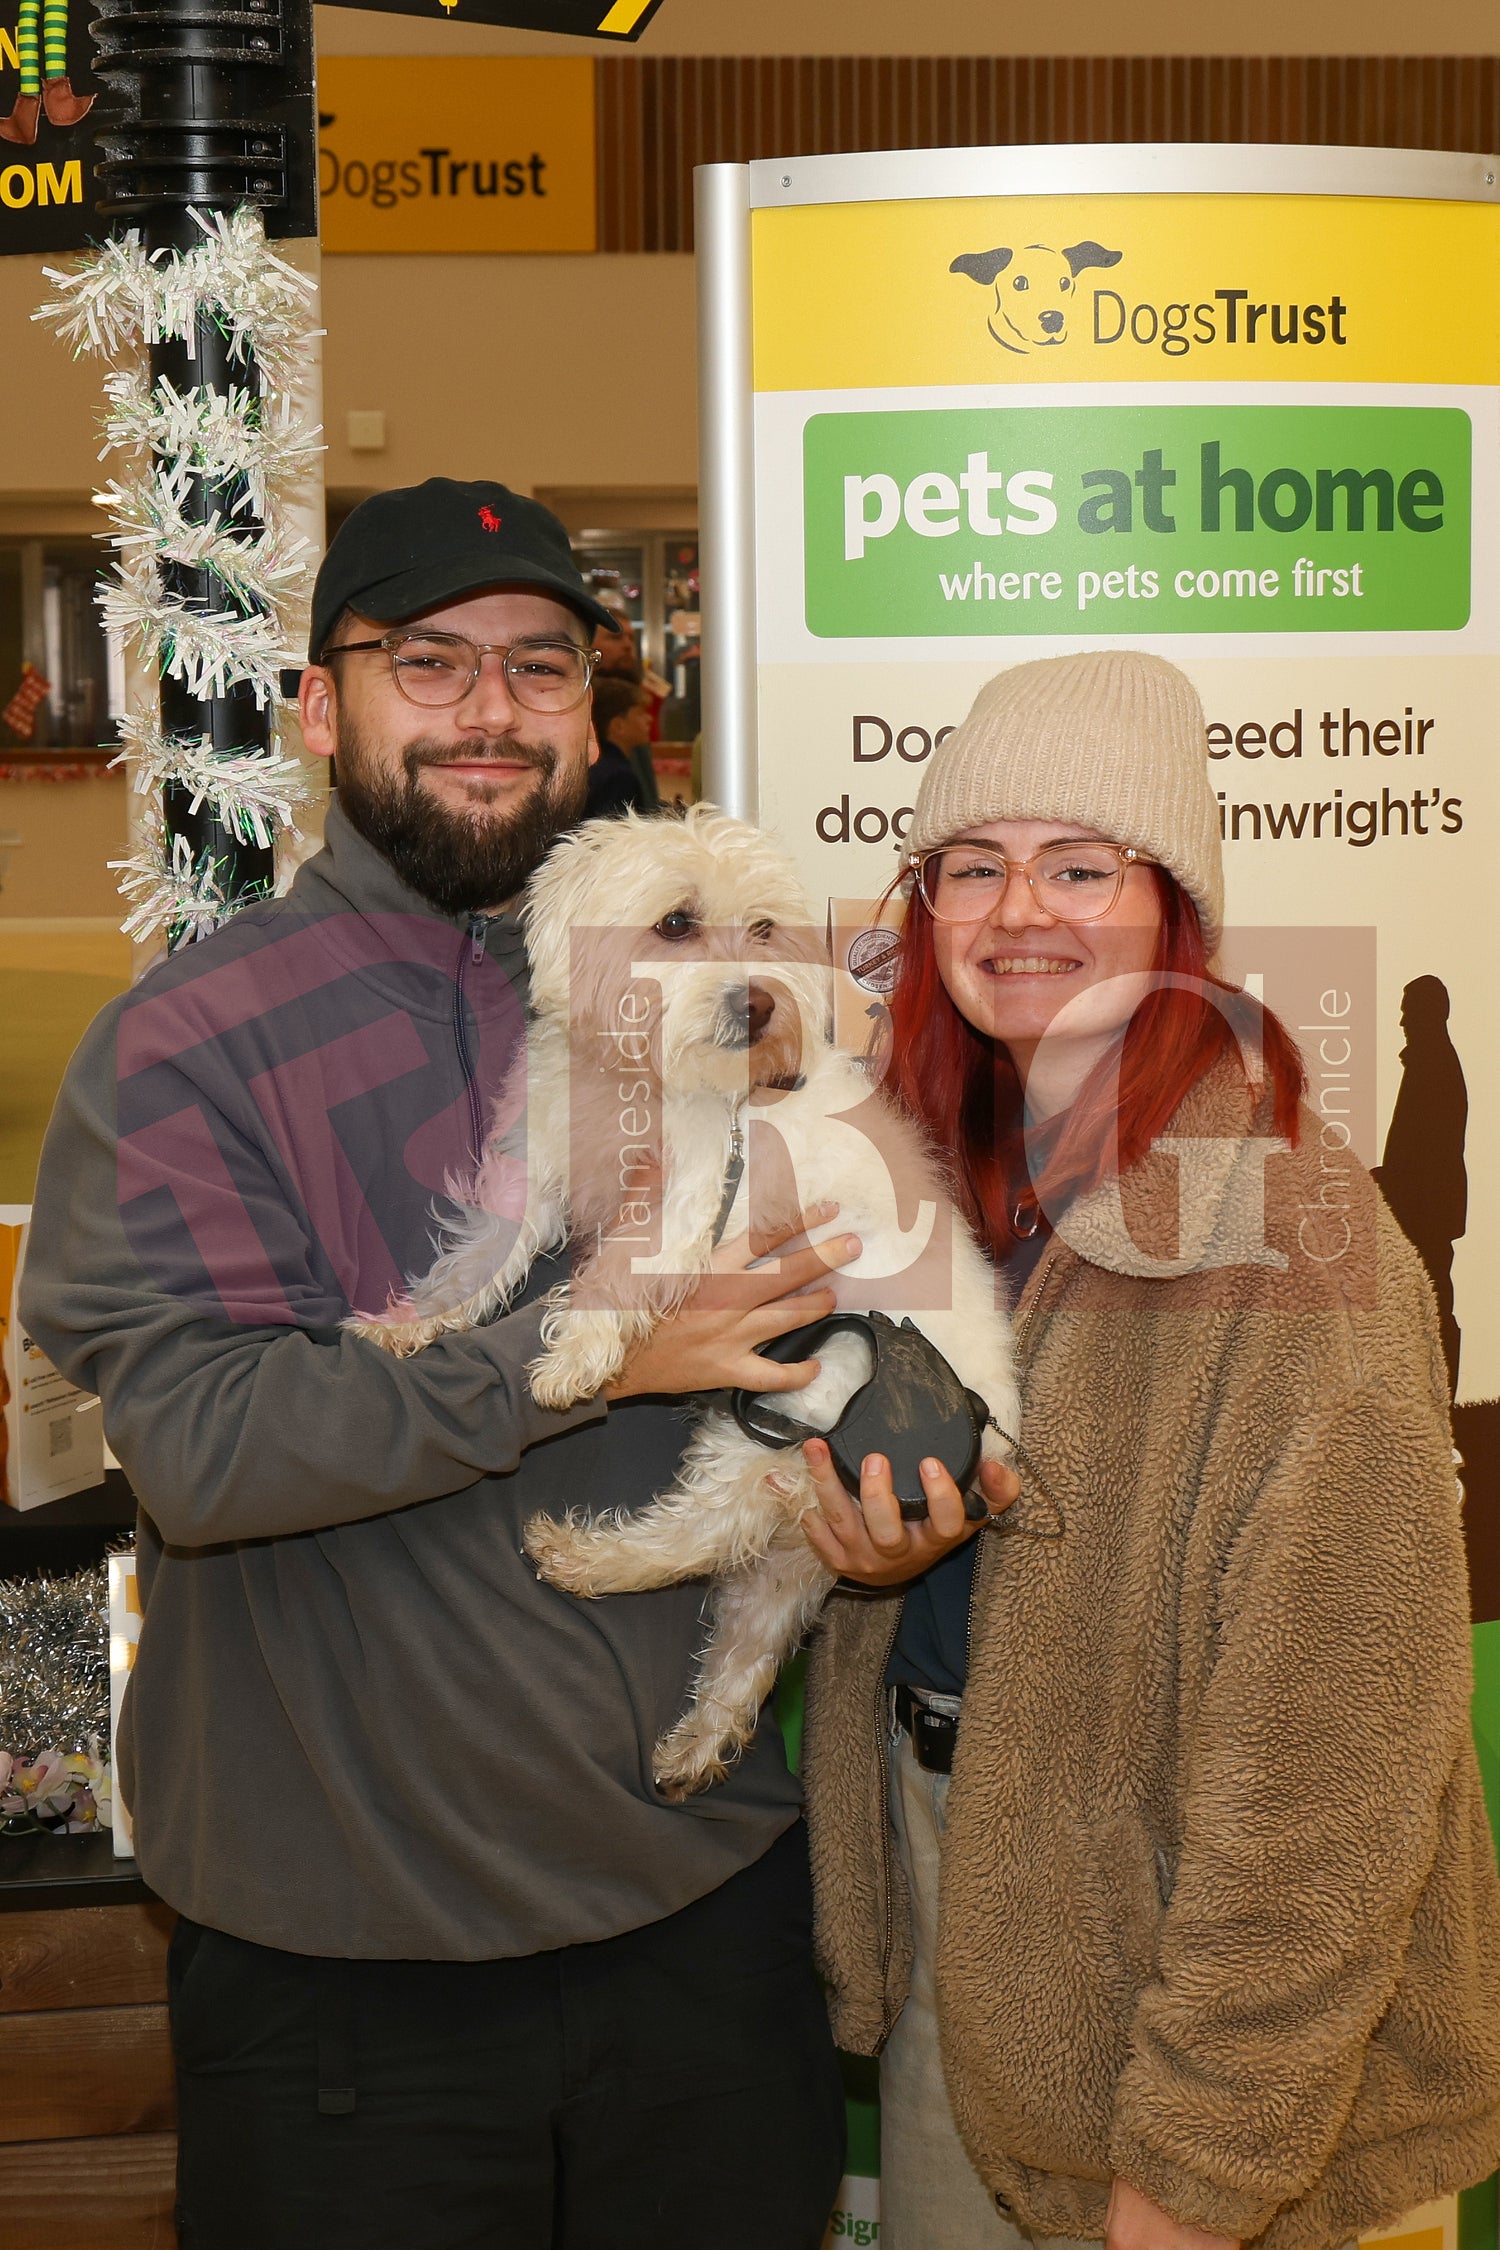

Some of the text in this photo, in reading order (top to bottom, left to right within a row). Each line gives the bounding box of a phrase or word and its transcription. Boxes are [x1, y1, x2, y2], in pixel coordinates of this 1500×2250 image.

[1093, 290, 1347, 356] DogsTrust
[844, 440, 1445, 560] pets at home
[939, 557, 1364, 611] where pets come first
[1206, 708, 1303, 760] eed
[1319, 707, 1435, 758] their
[856, 956, 881, 973] TURKEY
